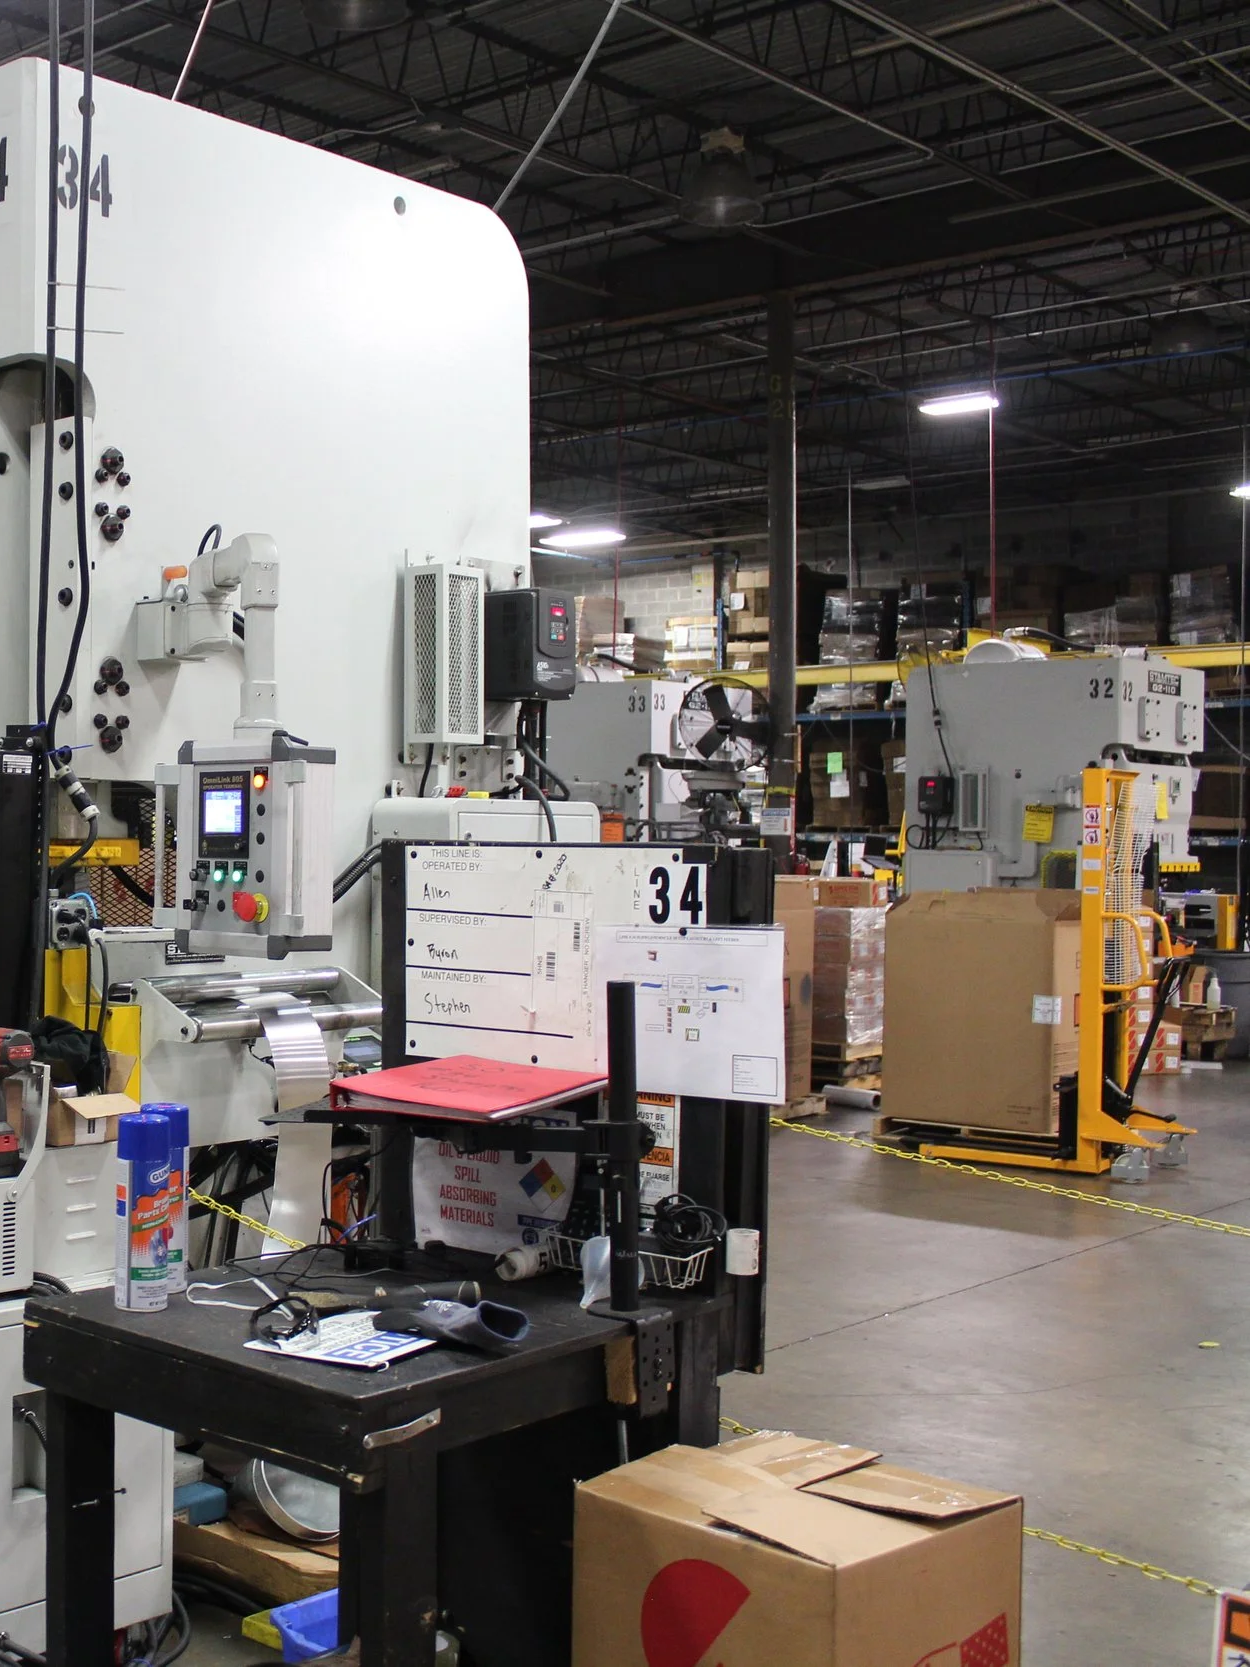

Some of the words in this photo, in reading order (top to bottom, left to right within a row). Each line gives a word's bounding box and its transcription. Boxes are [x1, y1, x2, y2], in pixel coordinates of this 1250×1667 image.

[57, 144, 112, 218] 34
[1089, 677, 1114, 699] 32
[1149, 671, 1180, 686] STAMTEC
[1122, 680, 1133, 702] 32
[628, 694, 646, 713] 33
[653, 693, 666, 711] 33
[431, 848, 449, 858] THIS
[451, 849, 470, 858] LINE
[472, 850, 483, 858] IS:
[422, 860, 467, 871] OPERATED
[469, 862, 483, 871] BY:
[423, 882, 450, 901] Allen
[633, 867, 641, 911] LINE
[648, 865, 703, 925] 34
[418, 912, 471, 925] SUPERVISED
[473, 916, 487, 926] BY:
[426, 943, 458, 962] Byron
[421, 970, 470, 983] MAINTAINED
[473, 974, 487, 984] BY:
[424, 992, 471, 1016] Stephen
[655, 1113, 665, 1121] BE
[438, 1142, 454, 1159] OIL
[152, 1167, 170, 1182] GUN
[454, 1165, 481, 1183] SPILL
[439, 1184, 497, 1207] ABSORBING
[440, 1205, 494, 1228] MATERIALS
[331, 1331, 419, 1361] TICE
